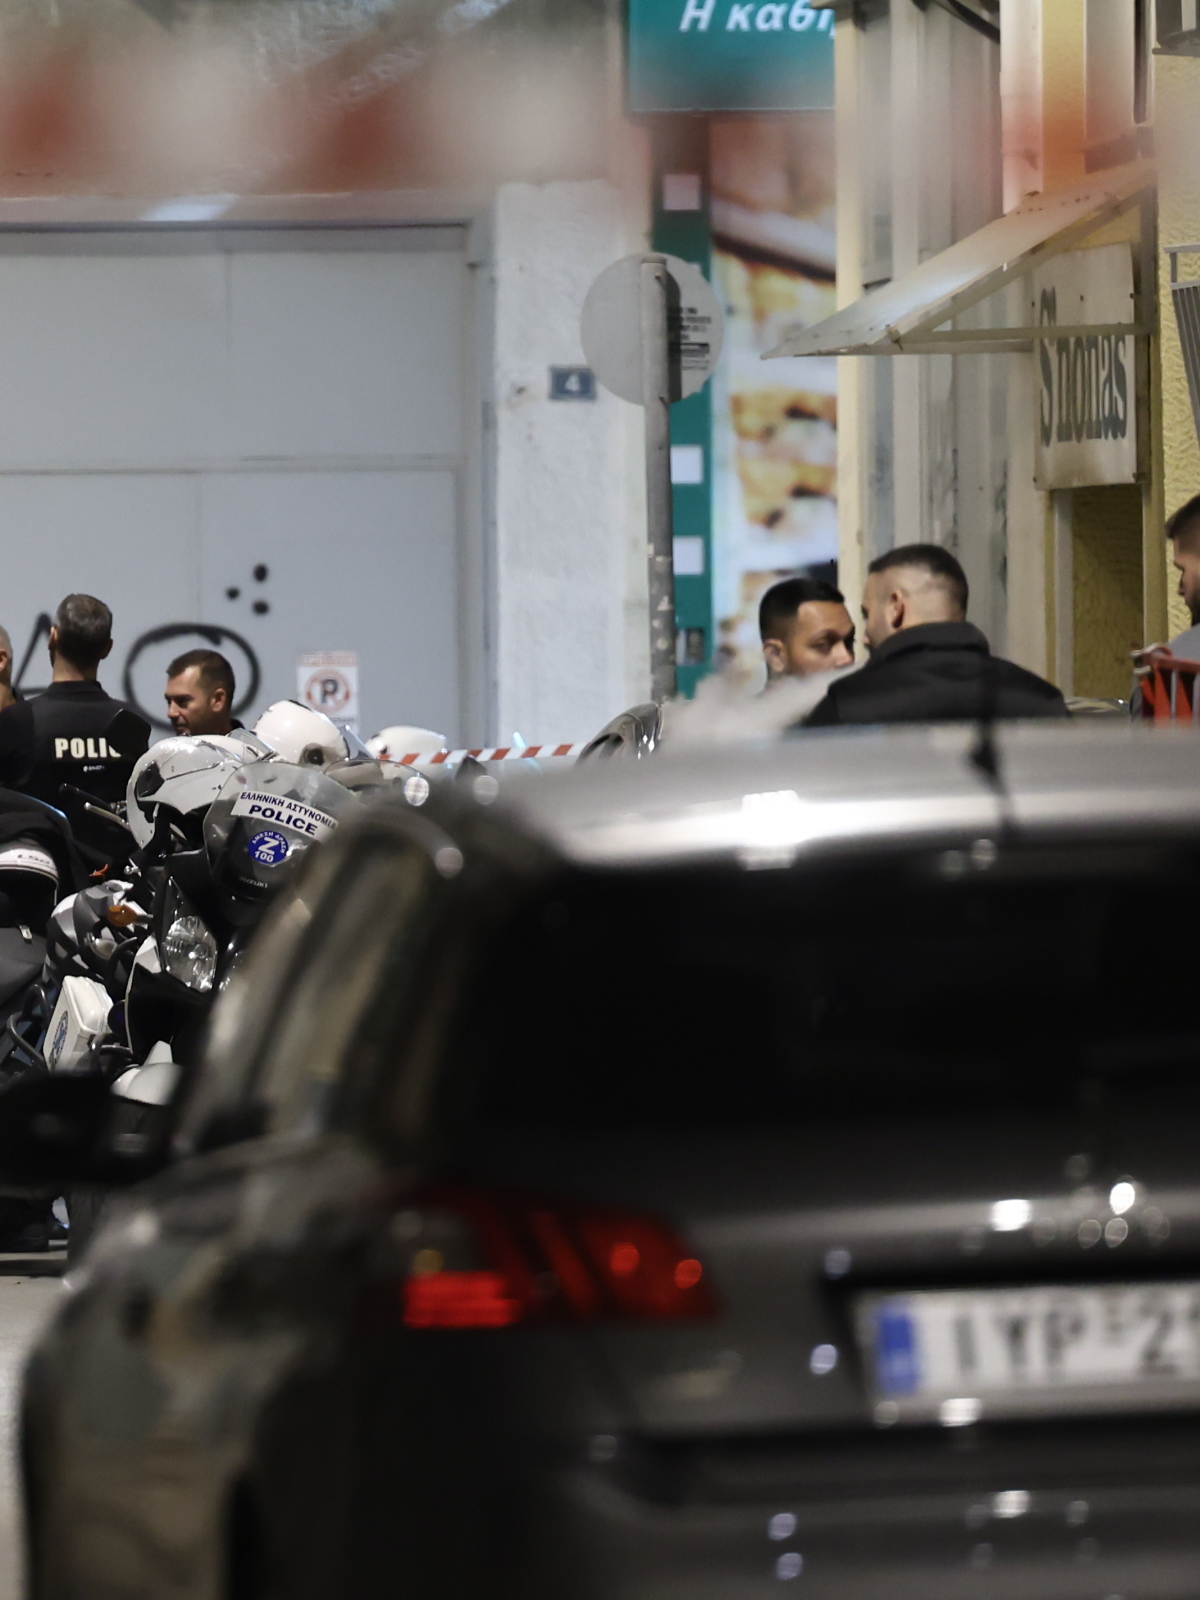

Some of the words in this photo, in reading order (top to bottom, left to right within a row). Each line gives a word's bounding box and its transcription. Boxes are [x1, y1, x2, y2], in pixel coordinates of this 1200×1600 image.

[564, 373, 580, 391] 4
[240, 791, 285, 808] ΕΛΛΗΝΙΚΗ
[285, 800, 339, 830] ΑΣΤΥΝΟΜΙΑ
[249, 804, 318, 836] POLICE
[254, 850, 274, 863] 100
